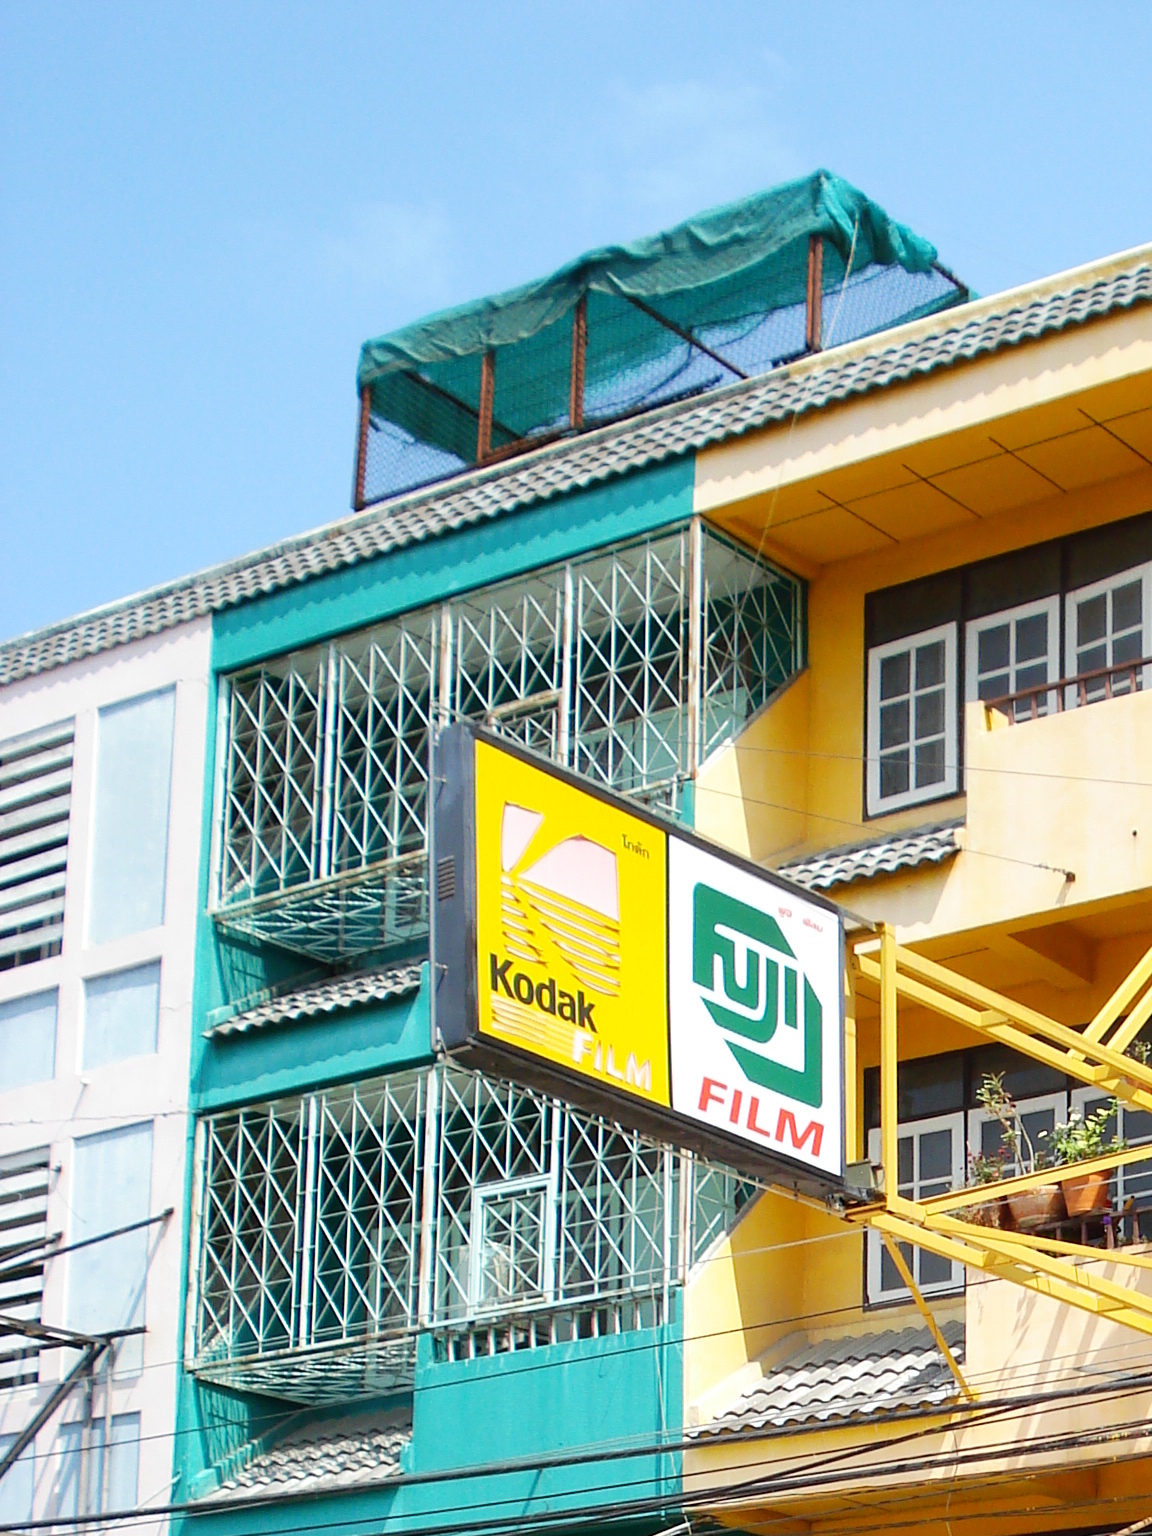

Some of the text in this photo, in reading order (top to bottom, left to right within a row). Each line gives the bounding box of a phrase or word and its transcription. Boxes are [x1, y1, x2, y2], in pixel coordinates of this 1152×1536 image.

[489, 953, 598, 1034] Kodak
[571, 1028, 652, 1093] FILM
[698, 1076, 824, 1157] FILM
